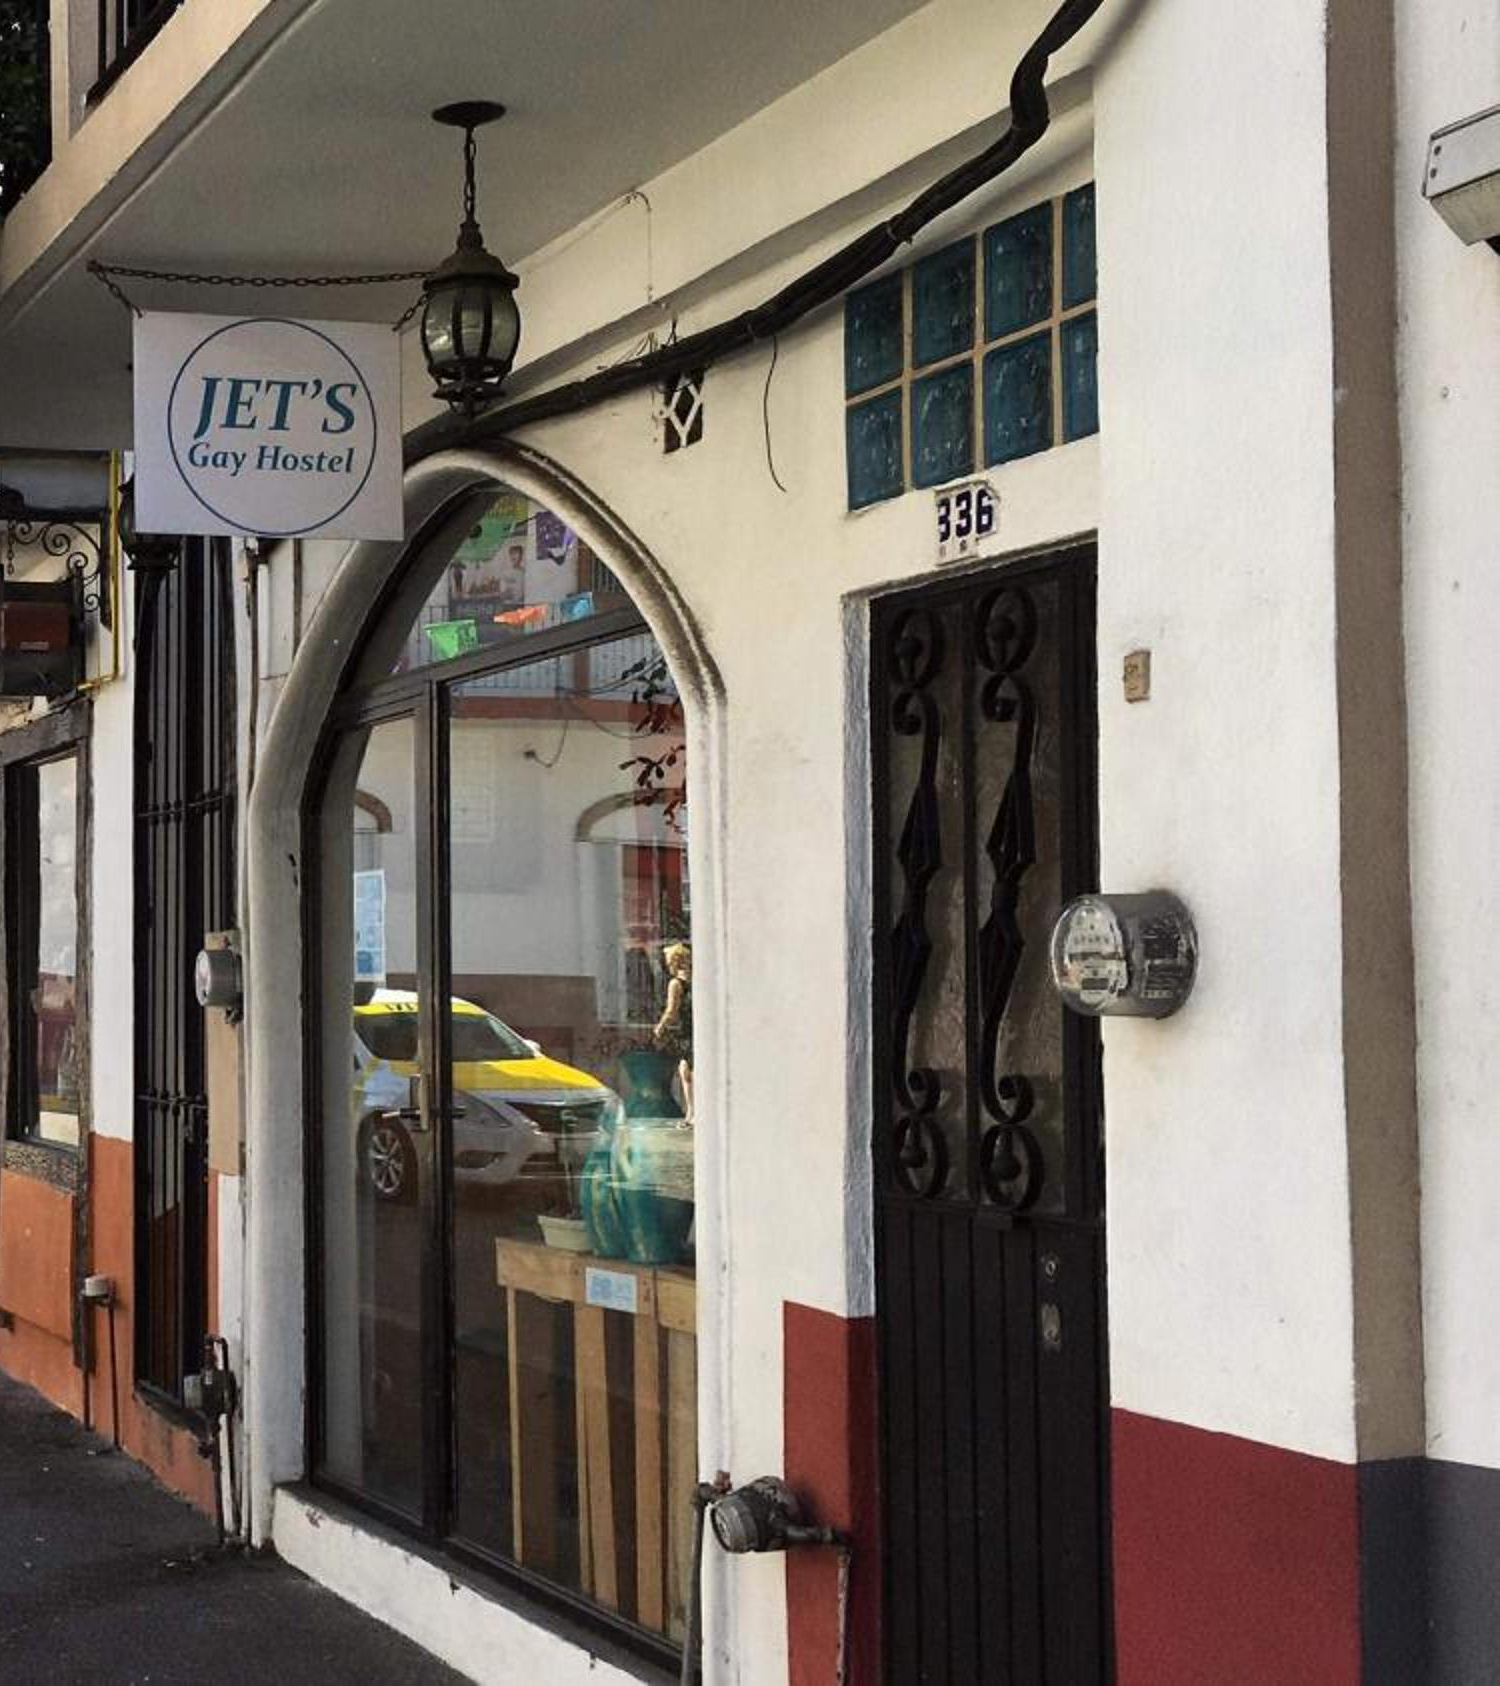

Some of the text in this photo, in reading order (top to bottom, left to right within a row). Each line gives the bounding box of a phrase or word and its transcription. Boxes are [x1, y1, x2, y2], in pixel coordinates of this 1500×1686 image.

[193, 376, 357, 440] JET'S
[188, 441, 357, 477] Gay Hostel
[937, 488, 994, 543] 336
